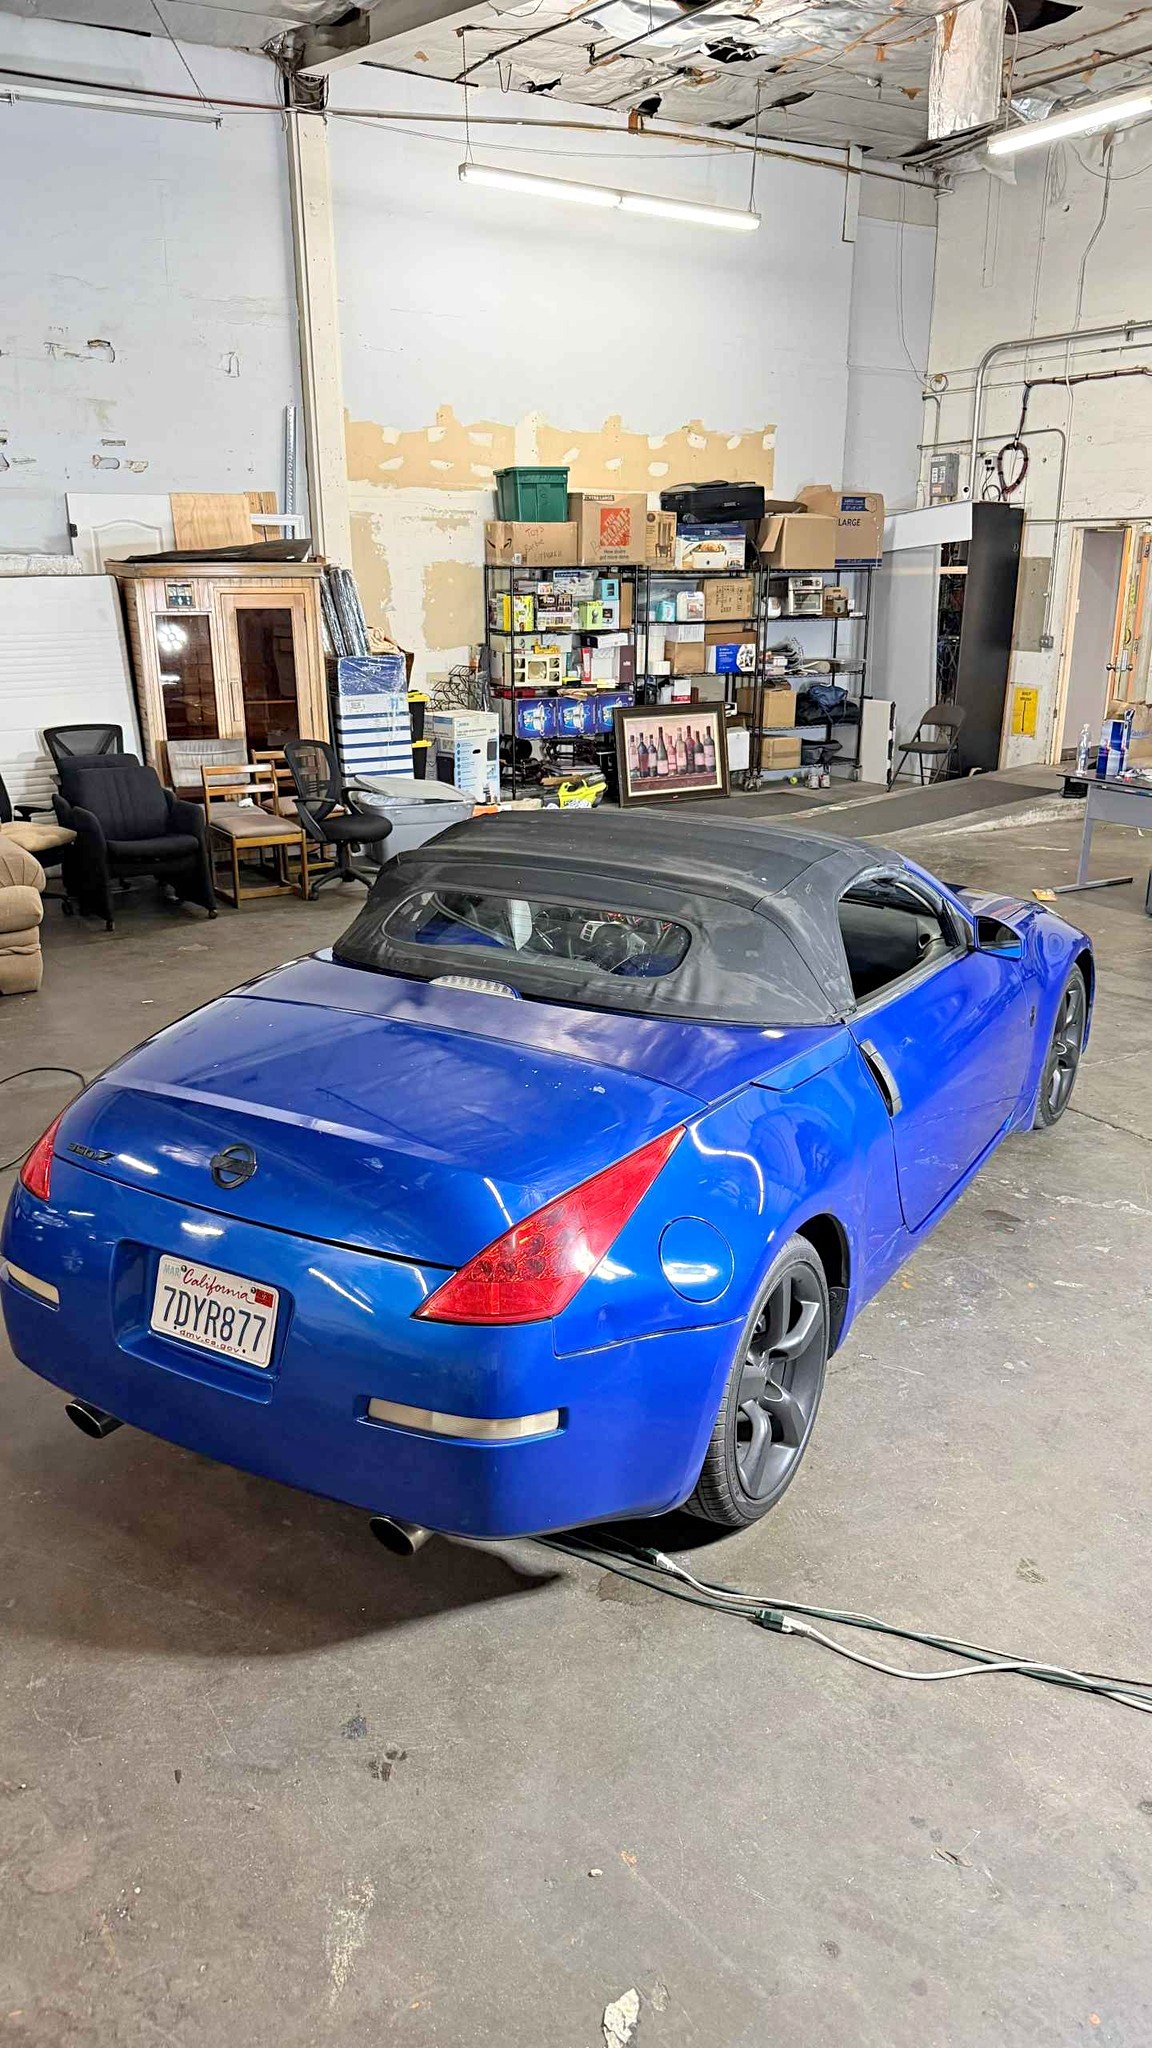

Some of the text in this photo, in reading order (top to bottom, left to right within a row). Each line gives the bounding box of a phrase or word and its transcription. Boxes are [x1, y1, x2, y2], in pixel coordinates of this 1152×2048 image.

[838, 518, 861, 527] LARGE
[183, 1268, 255, 1304] California
[163, 1285, 267, 1352] 7DYR877
[179, 1329, 240, 1353] dmv.ca.gov
